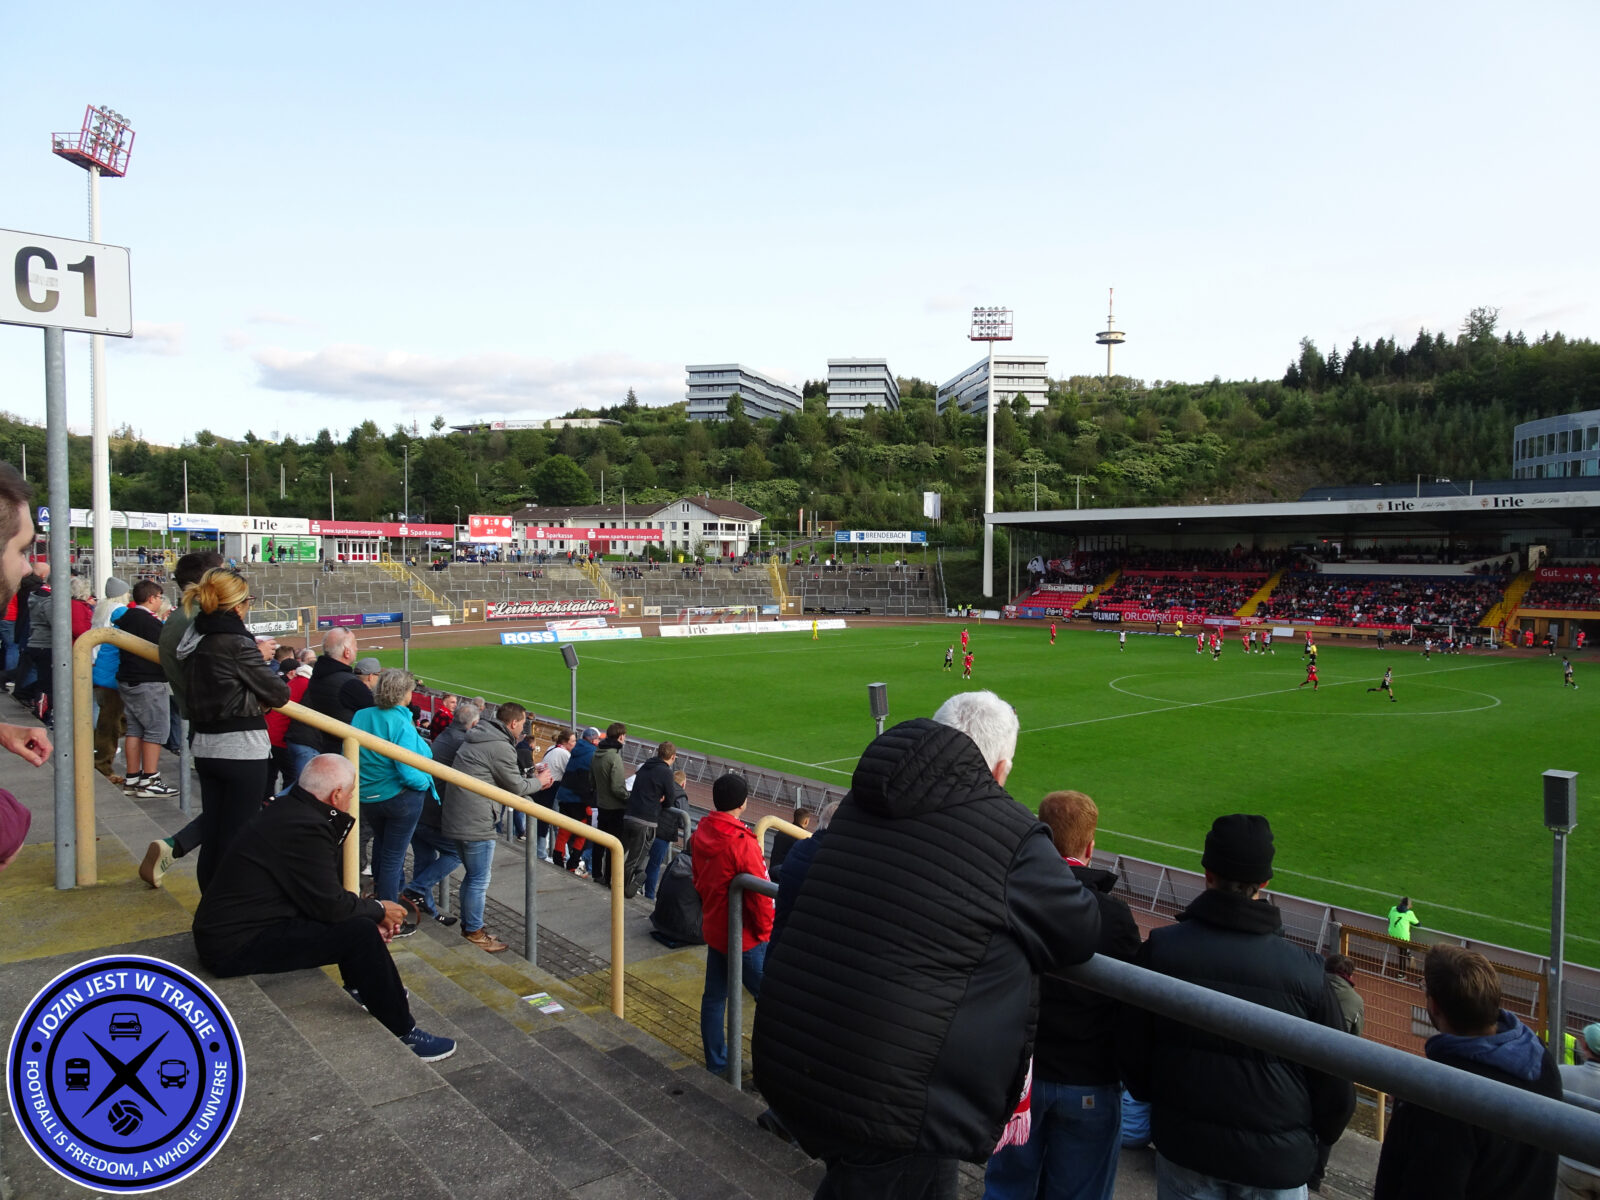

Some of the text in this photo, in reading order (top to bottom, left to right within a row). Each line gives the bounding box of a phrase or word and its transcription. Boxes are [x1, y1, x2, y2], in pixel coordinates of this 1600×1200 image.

[14, 246, 97, 318] C1
[1387, 500, 1415, 511] Irle
[1493, 496, 1524, 508] Irle
[253, 519, 278, 530] Irle
[322, 527, 383, 535] www.sparkasse-siegen.de
[410, 529, 442, 537] Sparkasse
[546, 531, 574, 539] Sparkasse
[865, 531, 907, 539] BRENDEBACH
[598, 533, 660, 541] www.sparkasse-siegen.de
[1540, 568, 1561, 577] Gut.
[493, 599, 610, 616] Leimbachstadion
[1098, 611, 1120, 621] LUNATIC
[1186, 614, 1204, 624] SFS
[503, 631, 556, 645] ROSS
